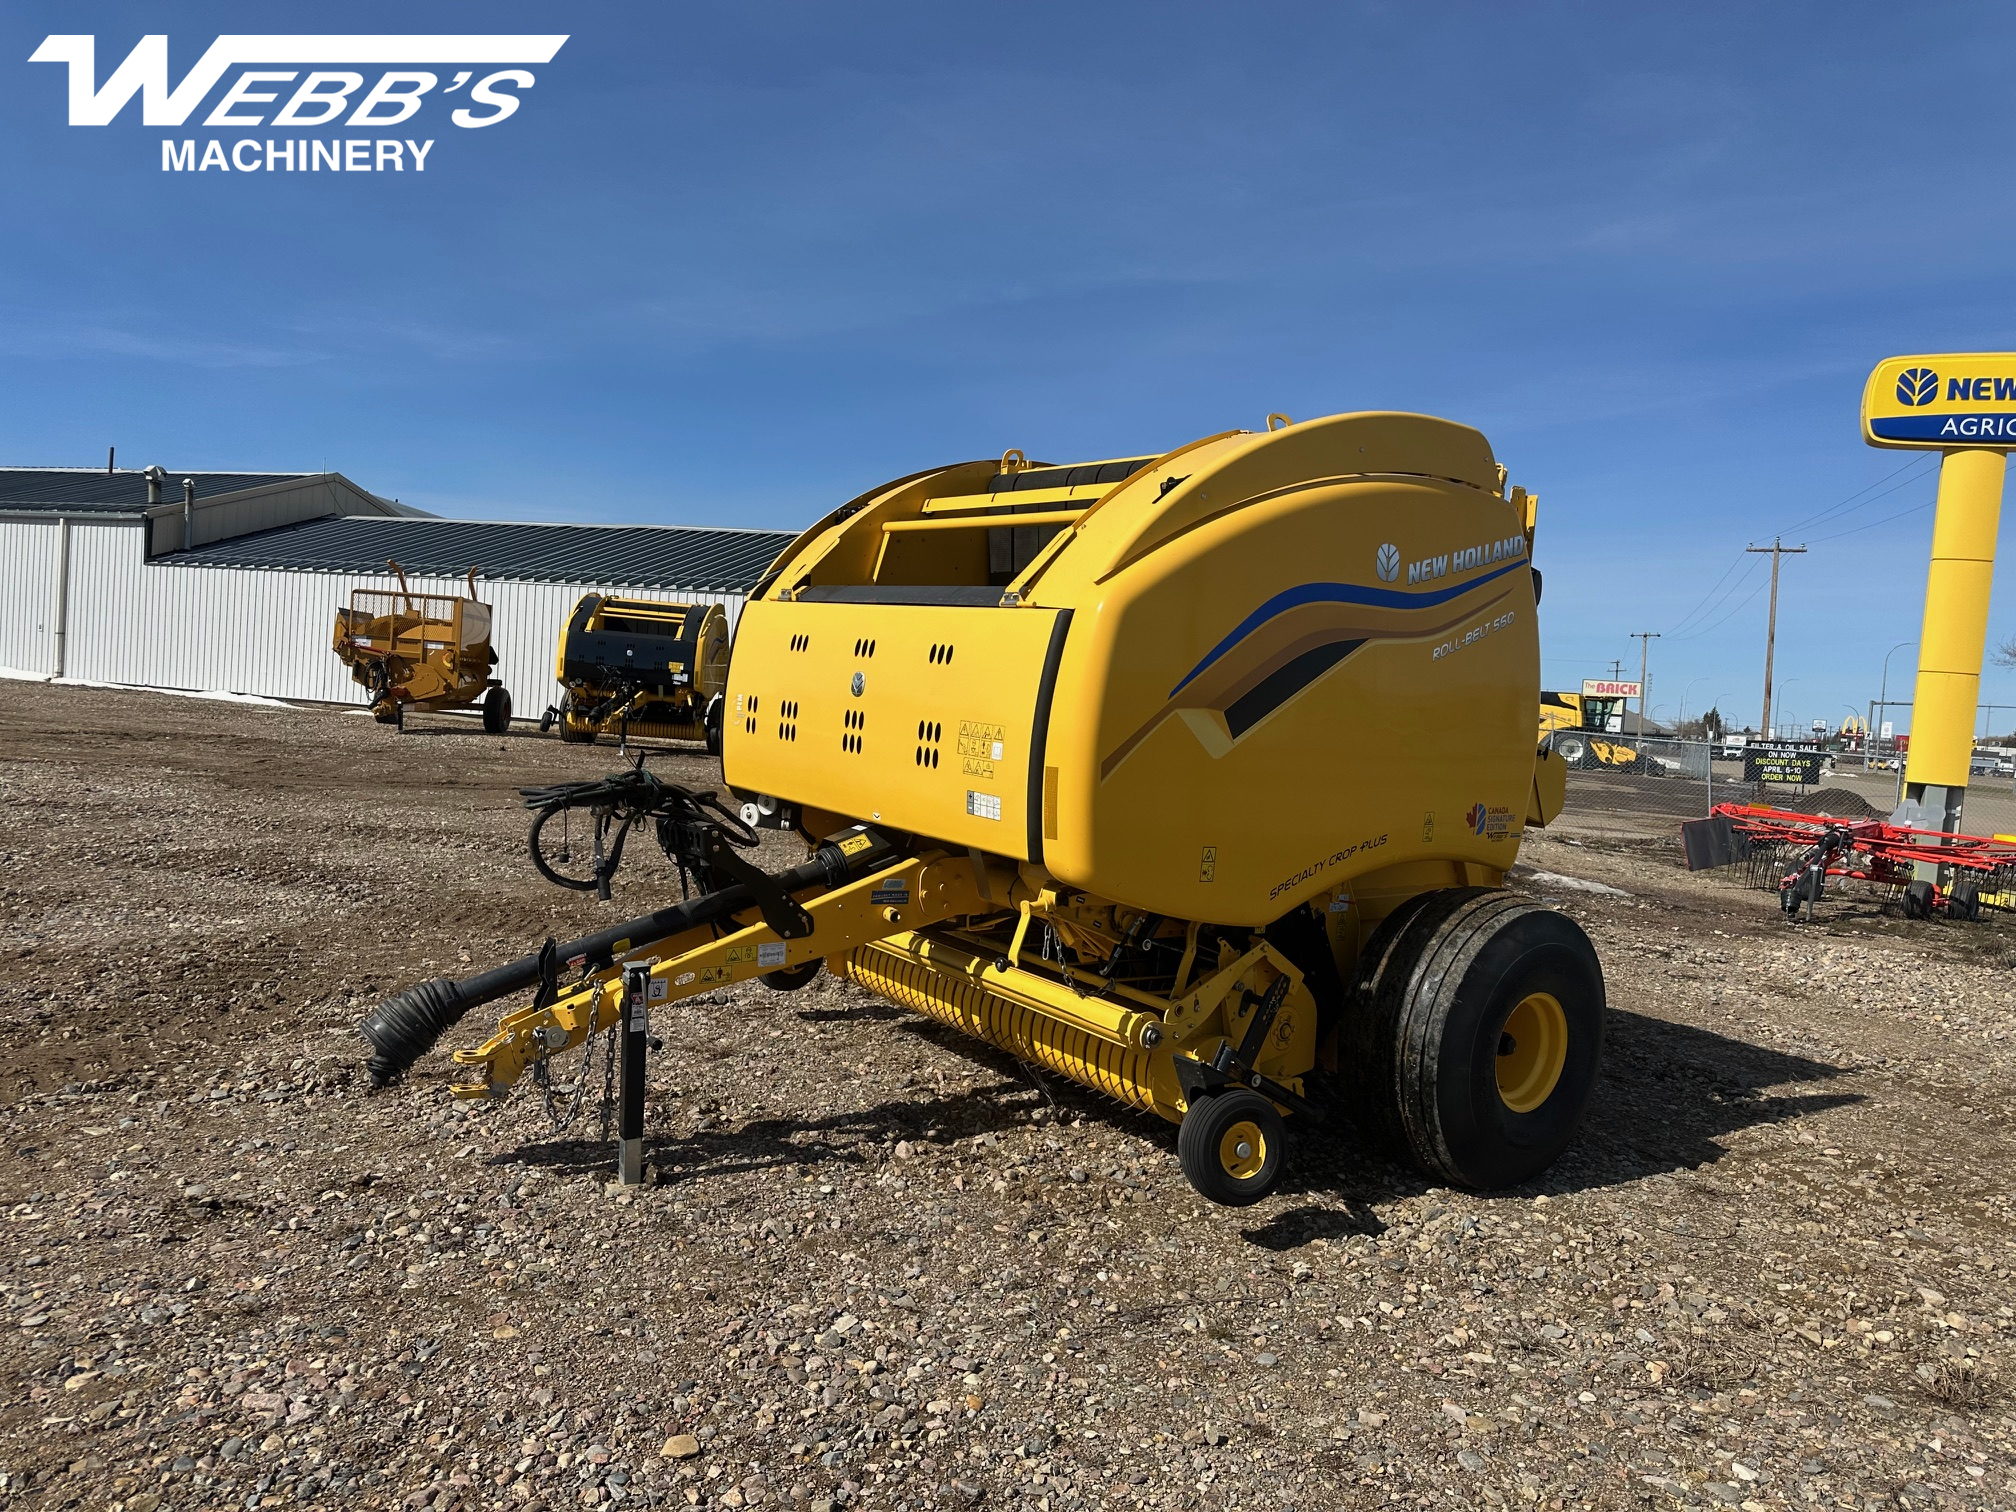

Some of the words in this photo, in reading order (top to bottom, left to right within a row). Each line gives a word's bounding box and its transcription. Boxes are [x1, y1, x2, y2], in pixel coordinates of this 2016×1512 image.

[1407, 554, 1448, 586] NEW
[1452, 535, 1525, 574] HOLLAND
[1432, 622, 1491, 661] ROLL-BELT
[1585, 681, 1595, 689] The
[1596, 682, 1638, 695] BRICK
[1799, 744, 1818, 752] SALE
[1780, 751, 1797, 759] NOW
[1755, 758, 1788, 766] DISCOUNT
[1761, 773, 1783, 781] ORDER
[1488, 806, 1509, 815] CANADA
[1487, 814, 1516, 823] SIGNATURE
[1486, 823, 1507, 831] EDITION
[1269, 858, 1327, 901] SPECIALTY
[1328, 845, 1358, 867] CROP
[1360, 834, 1388, 852] PLUS
